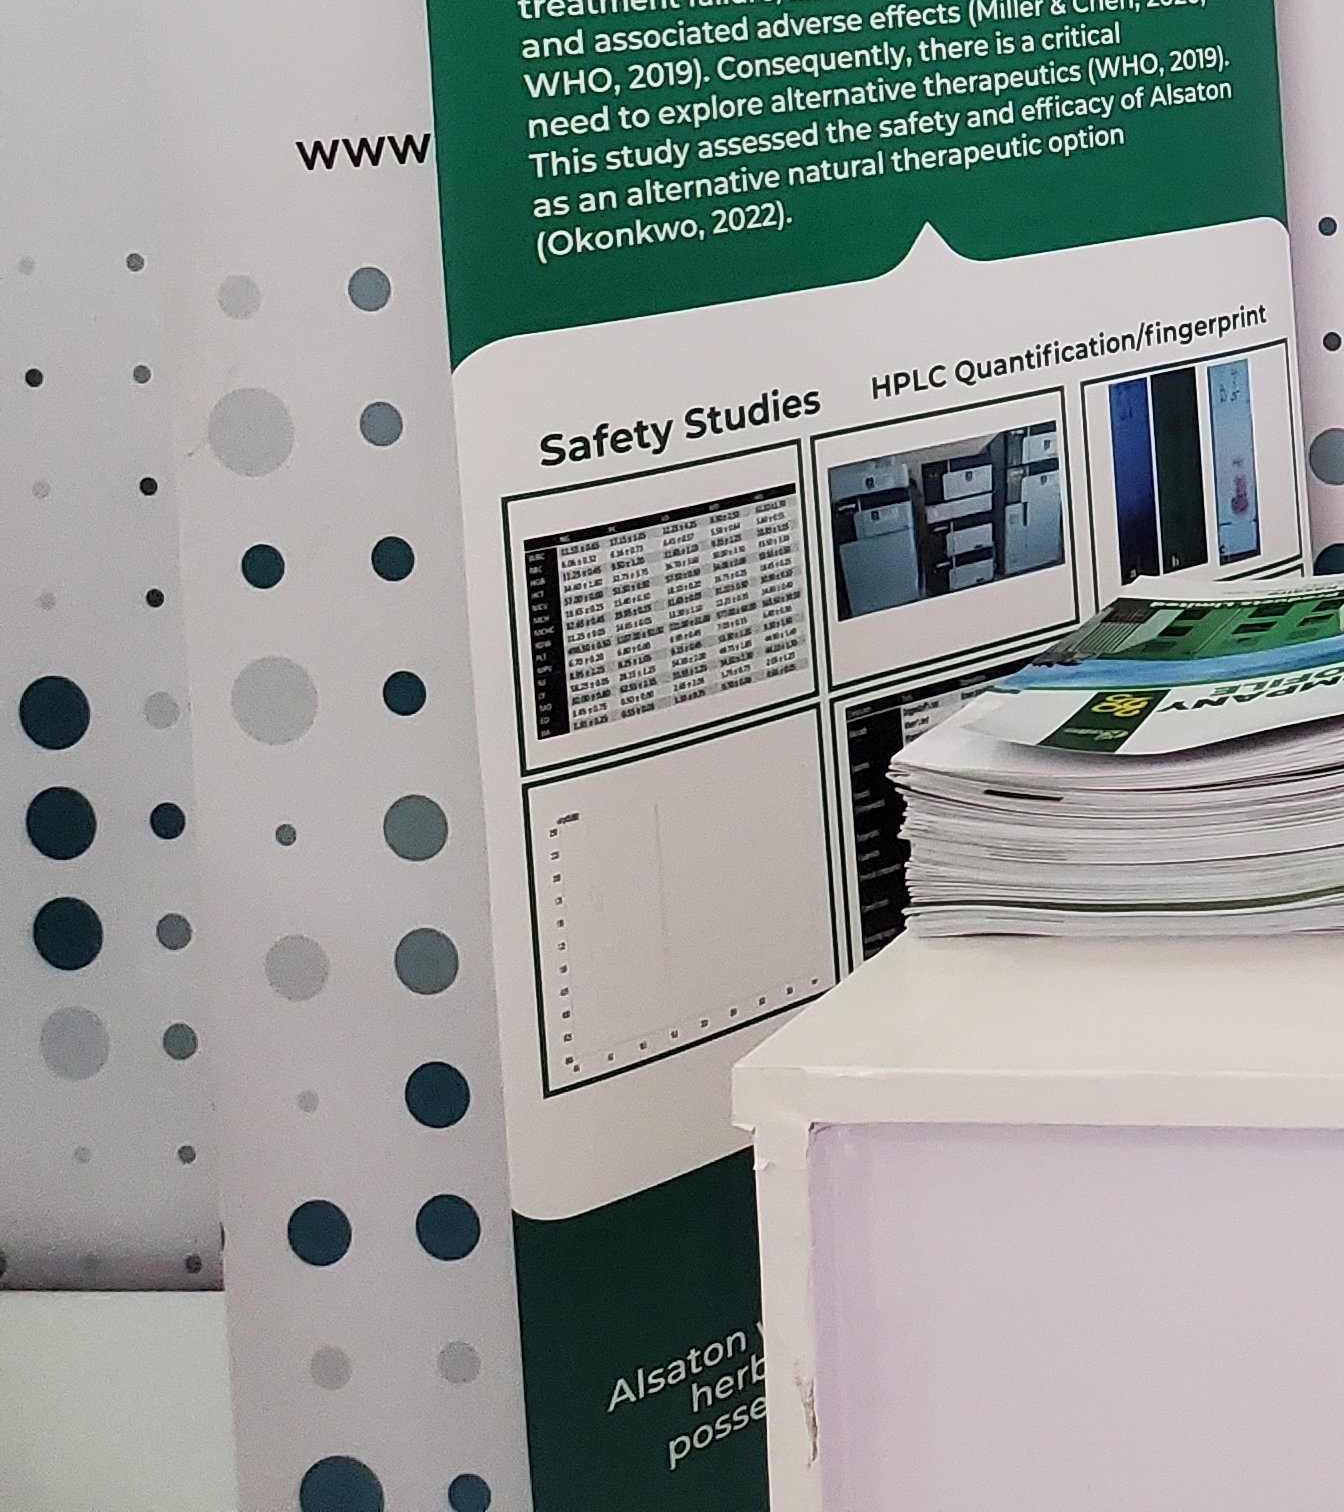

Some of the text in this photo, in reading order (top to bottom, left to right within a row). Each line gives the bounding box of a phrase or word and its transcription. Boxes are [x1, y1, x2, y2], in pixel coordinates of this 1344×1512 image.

[538, 201, 792, 263] (Okonkwo, 2022).
[872, 305, 1267, 399] HPLC Quantification/fingerprint
[541, 389, 820, 466] Safety Studies
[608, 1332, 748, 1412] Alsaton
